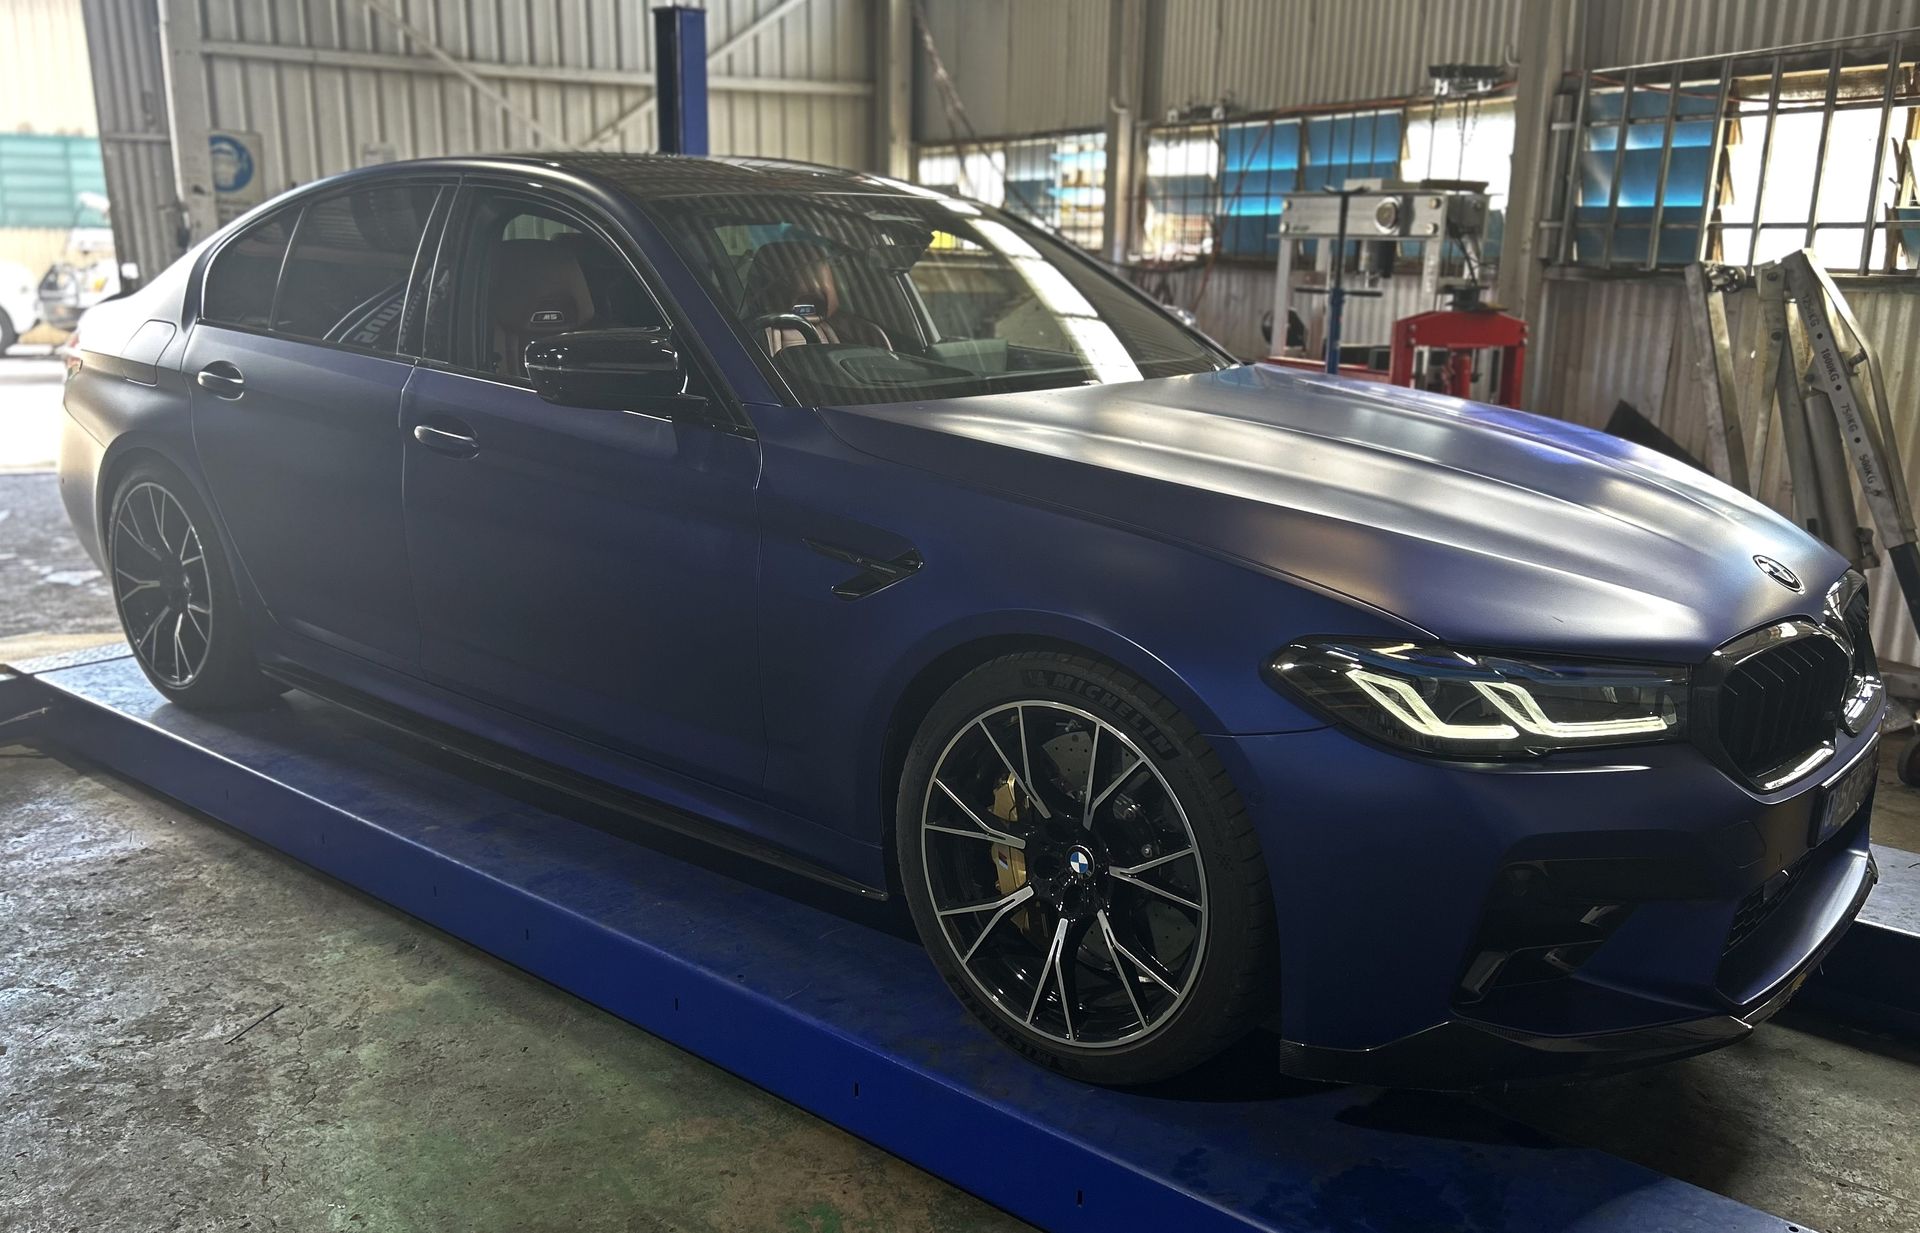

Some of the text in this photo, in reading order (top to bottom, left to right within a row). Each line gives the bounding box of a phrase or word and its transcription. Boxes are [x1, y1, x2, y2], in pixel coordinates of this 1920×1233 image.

[1820, 348, 1840, 382] 1000KG
[1840, 402, 1858, 433] 750KG
[1858, 454, 1878, 485] 500KG
[1051, 673, 1173, 755] MICHELIN
